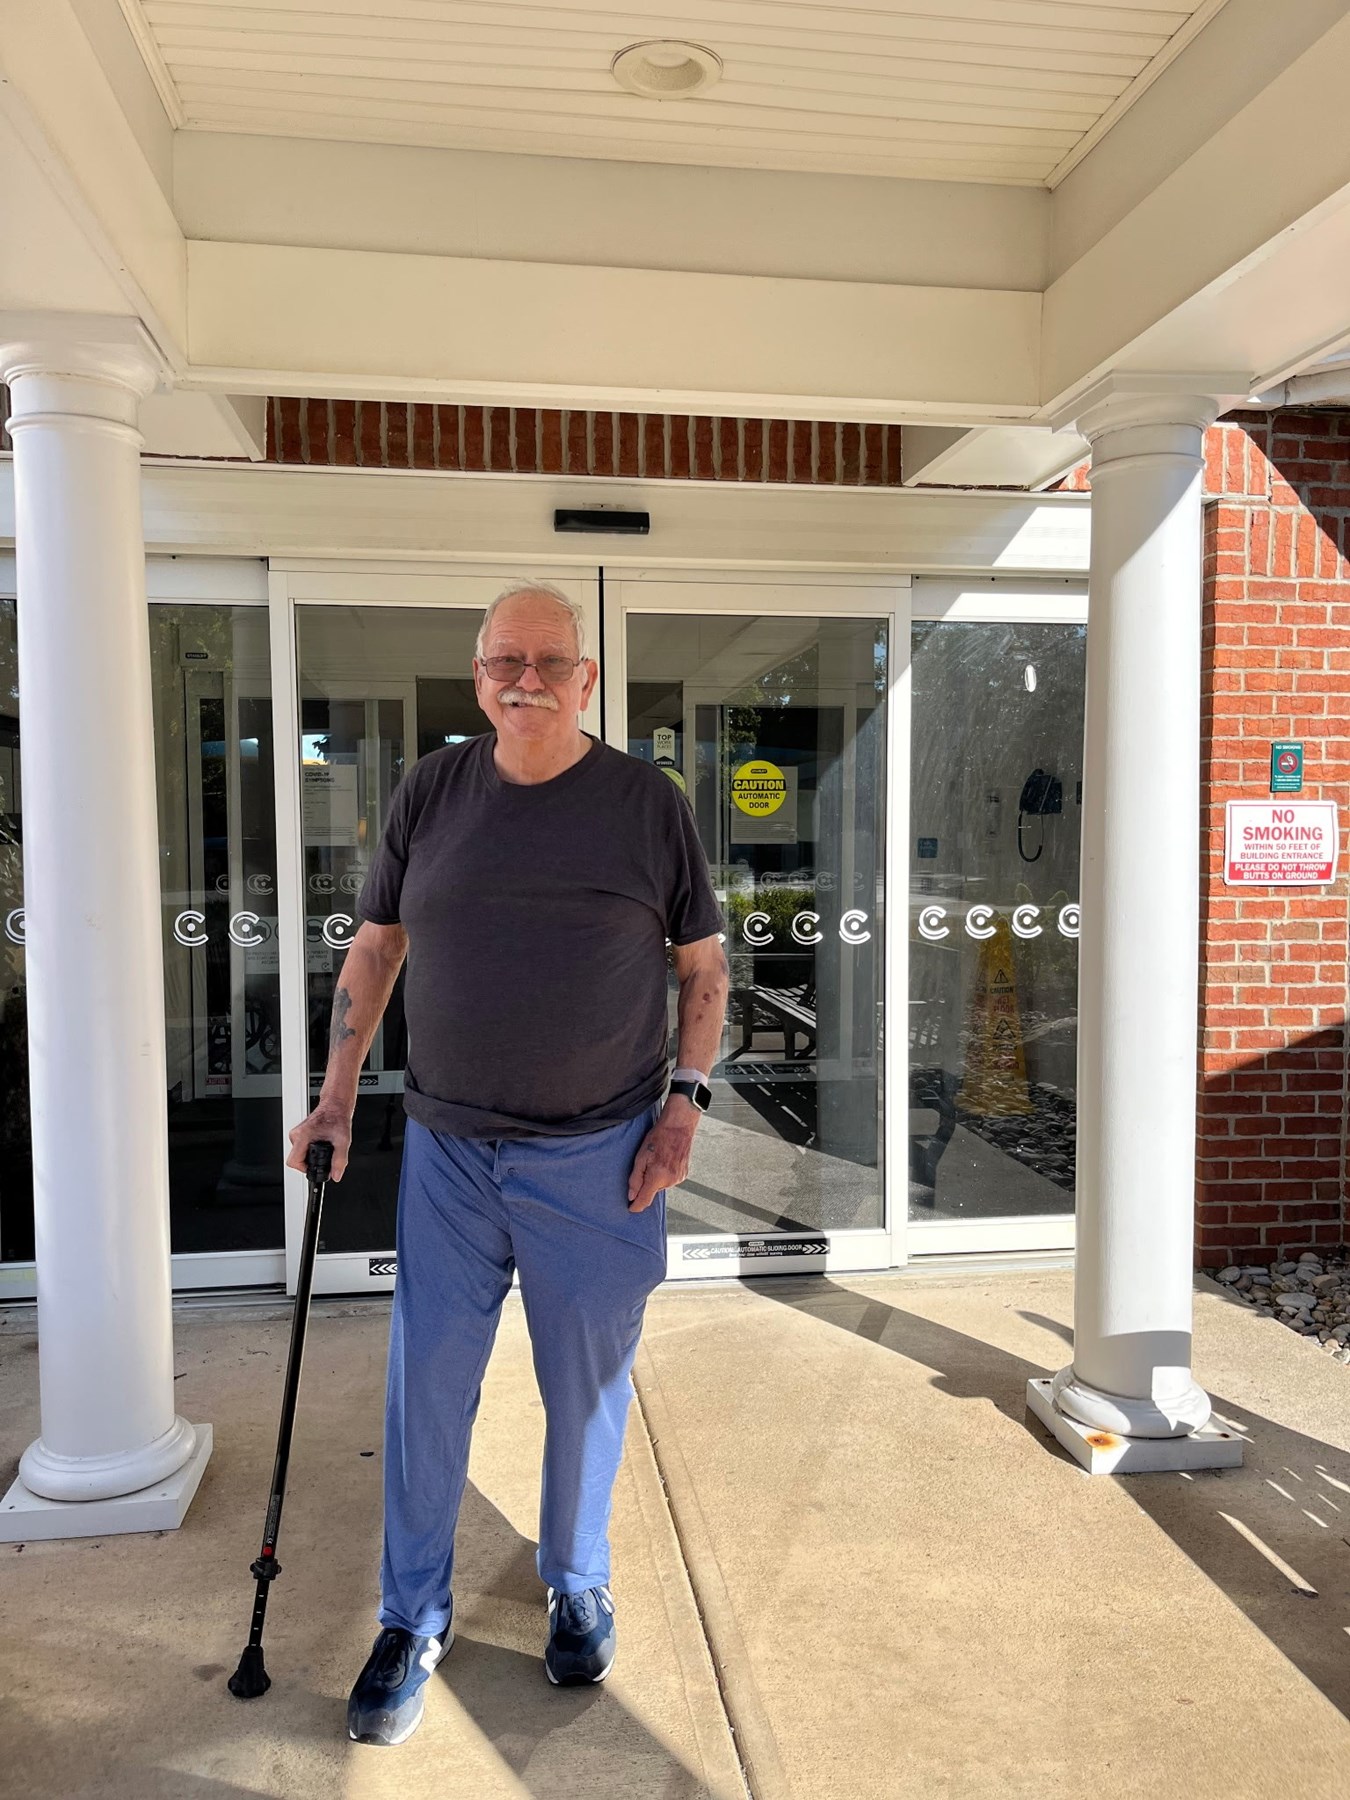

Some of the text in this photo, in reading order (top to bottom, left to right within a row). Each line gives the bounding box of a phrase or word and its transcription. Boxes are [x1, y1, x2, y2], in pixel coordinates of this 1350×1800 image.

[734, 780, 784, 790] CAUTION
[1272, 810, 1295, 823] NO
[1243, 827, 1323, 841] SMOKING
[1235, 863, 1266, 871] PLEASE
[990, 986, 1014, 994] CAUTION
